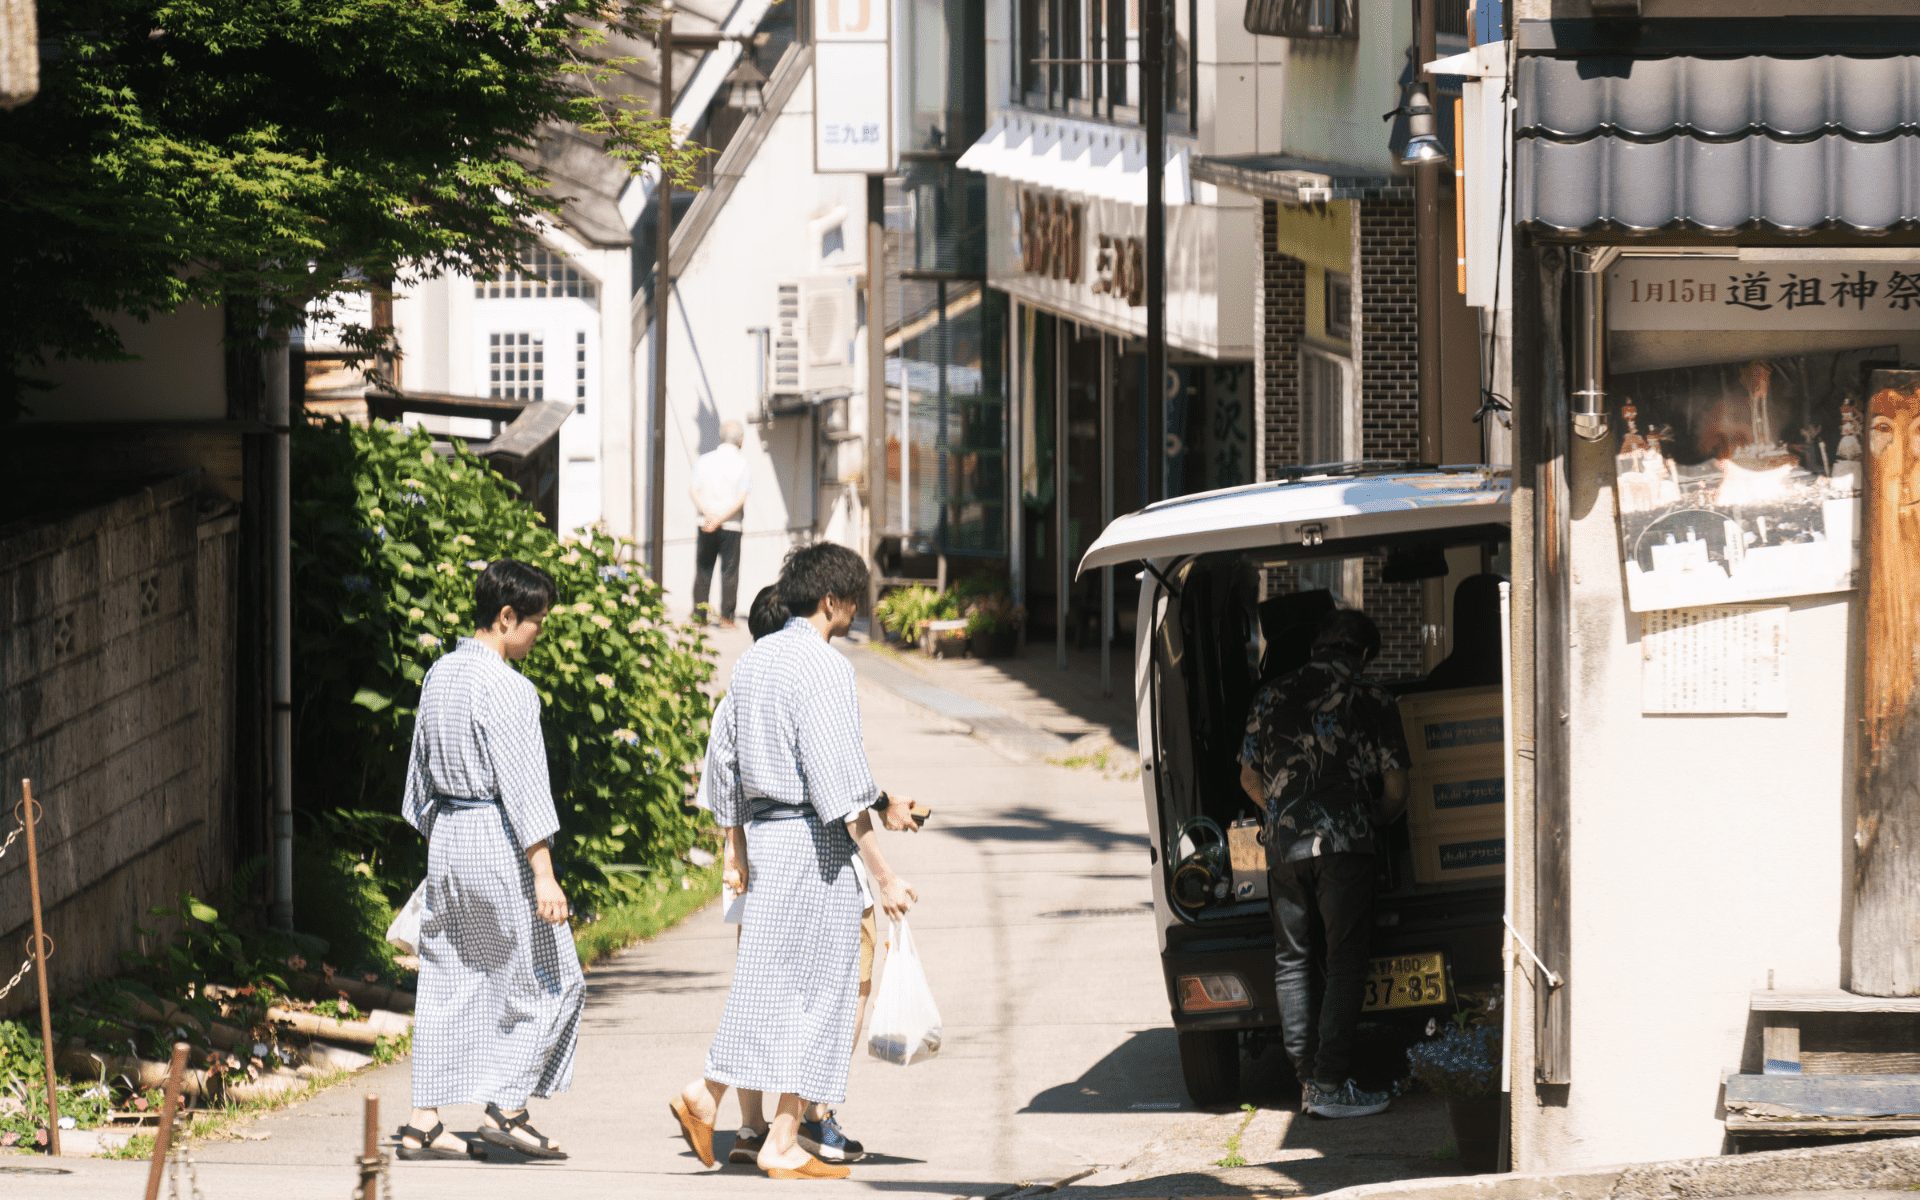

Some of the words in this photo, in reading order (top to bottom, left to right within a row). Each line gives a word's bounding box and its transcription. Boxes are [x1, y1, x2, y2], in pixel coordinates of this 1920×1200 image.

[824, 122, 881, 145] 三九郎
[1628, 278, 1717, 303] 1月15日
[1724, 269, 1920, 311] 道祖神祭
[1364, 973, 1441, 1006] 37-85
